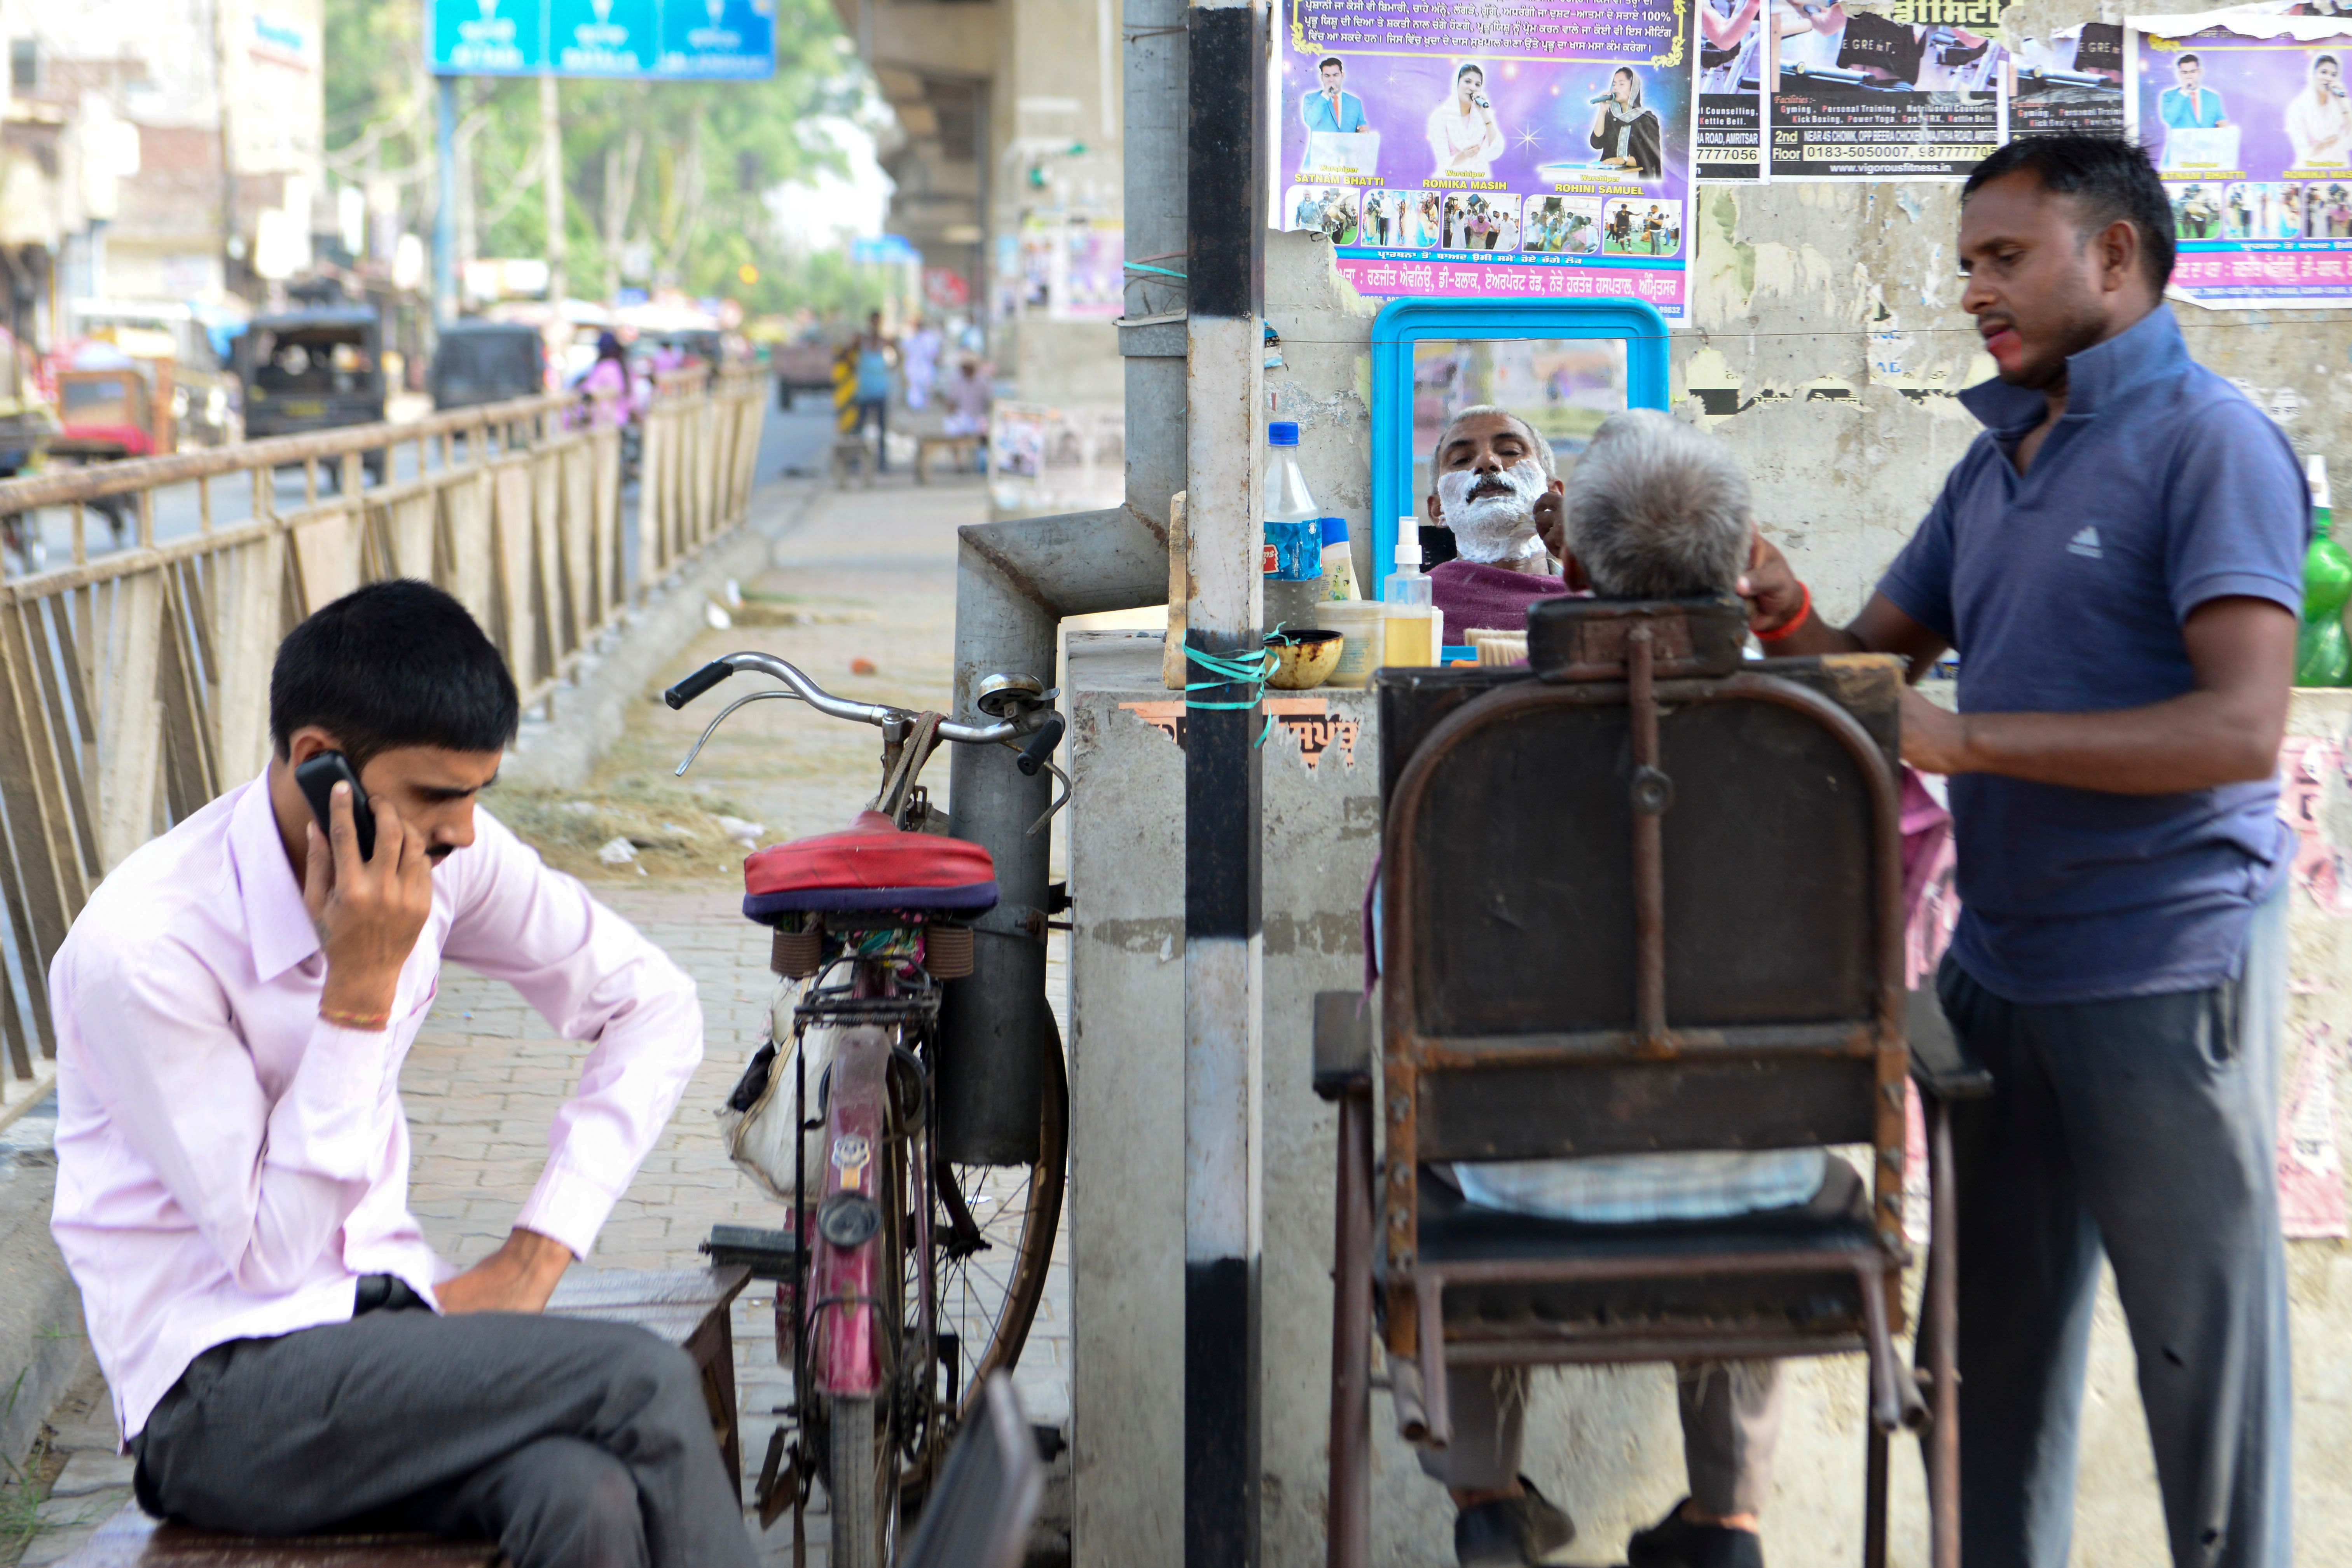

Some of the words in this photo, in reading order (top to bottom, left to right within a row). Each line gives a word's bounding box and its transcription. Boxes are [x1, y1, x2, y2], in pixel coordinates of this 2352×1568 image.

[1642, 11, 1671, 22] 100%
[1706, 133, 1725, 145] ROAD,
[1726, 133, 1758, 144] AMRITSAR
[1775, 131, 1798, 142] 2nd
[1697, 149, 1757, 160] 7777056
[1772, 147, 1801, 159] Floor
[1919, 147, 1998, 157] 987777705
[1294, 174, 1339, 184] SATNAM
[1343, 176, 1384, 186] BHATTI
[1423, 179, 1467, 189] ROMIKA
[1470, 181, 1507, 190] MASIH
[1555, 183, 1595, 194] ROHINI
[1599, 185, 1645, 195] SAMUEL
[1367, 264, 1397, 286] ਰਣਜੀਤ
